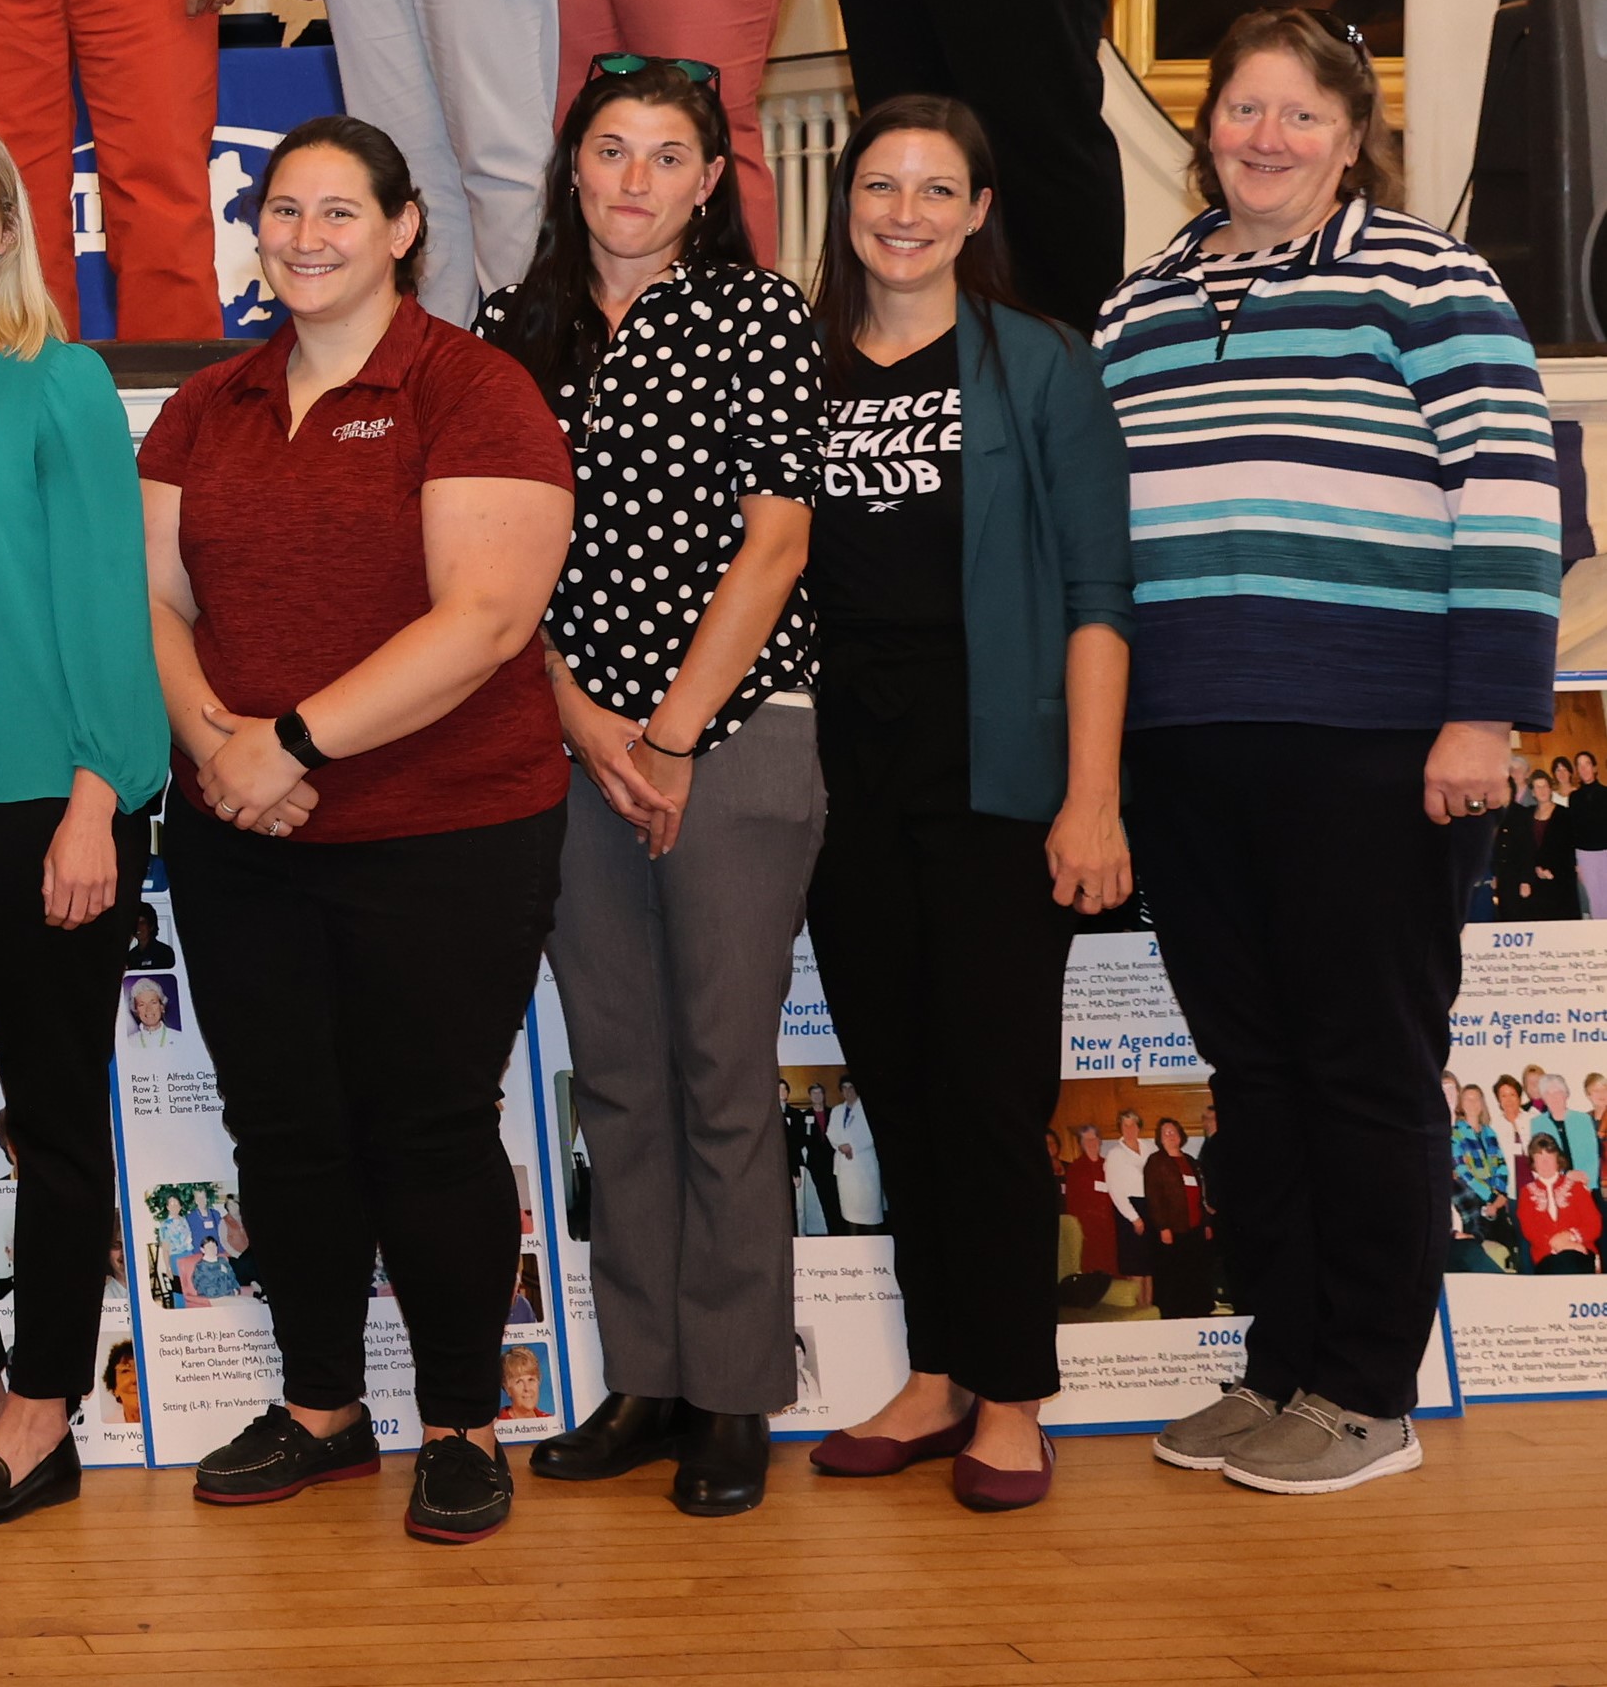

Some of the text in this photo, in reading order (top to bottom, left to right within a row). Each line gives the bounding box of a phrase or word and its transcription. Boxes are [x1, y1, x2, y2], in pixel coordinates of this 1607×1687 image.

[332, 416, 394, 437] CHELSEA
[338, 429, 386, 443] ATHLETICS
[826, 421, 962, 458] EMALE
[824, 459, 942, 497] CLUB
[1492, 932, 1534, 948] 2007
[1449, 1012, 1484, 1027] New
[1489, 1010, 1561, 1030] Agenda:
[1071, 1032, 1193, 1054] New Agenda:
[1450, 1031, 1486, 1046] Hall
[1493, 1030, 1513, 1049] of
[1520, 1030, 1566, 1044] Fame
[1076, 1053, 1197, 1072] Hall of Fame
[167, 1073, 194, 1081] Alfreda
[168, 1083, 200, 1092] Dorothy
[807, 1269, 837, 1278] Virginia
[1569, 1302, 1607, 1318] 2008
[219, 1329, 269, 1341] Jean Condon
[1198, 1329, 1242, 1347] 2006
[182, 1358, 239, 1369] Karen Olander
[163, 1402, 187, 1412] Sitting
[371, 1419, 399, 1435] 002
[514, 1425, 548, 1434] Adamski
